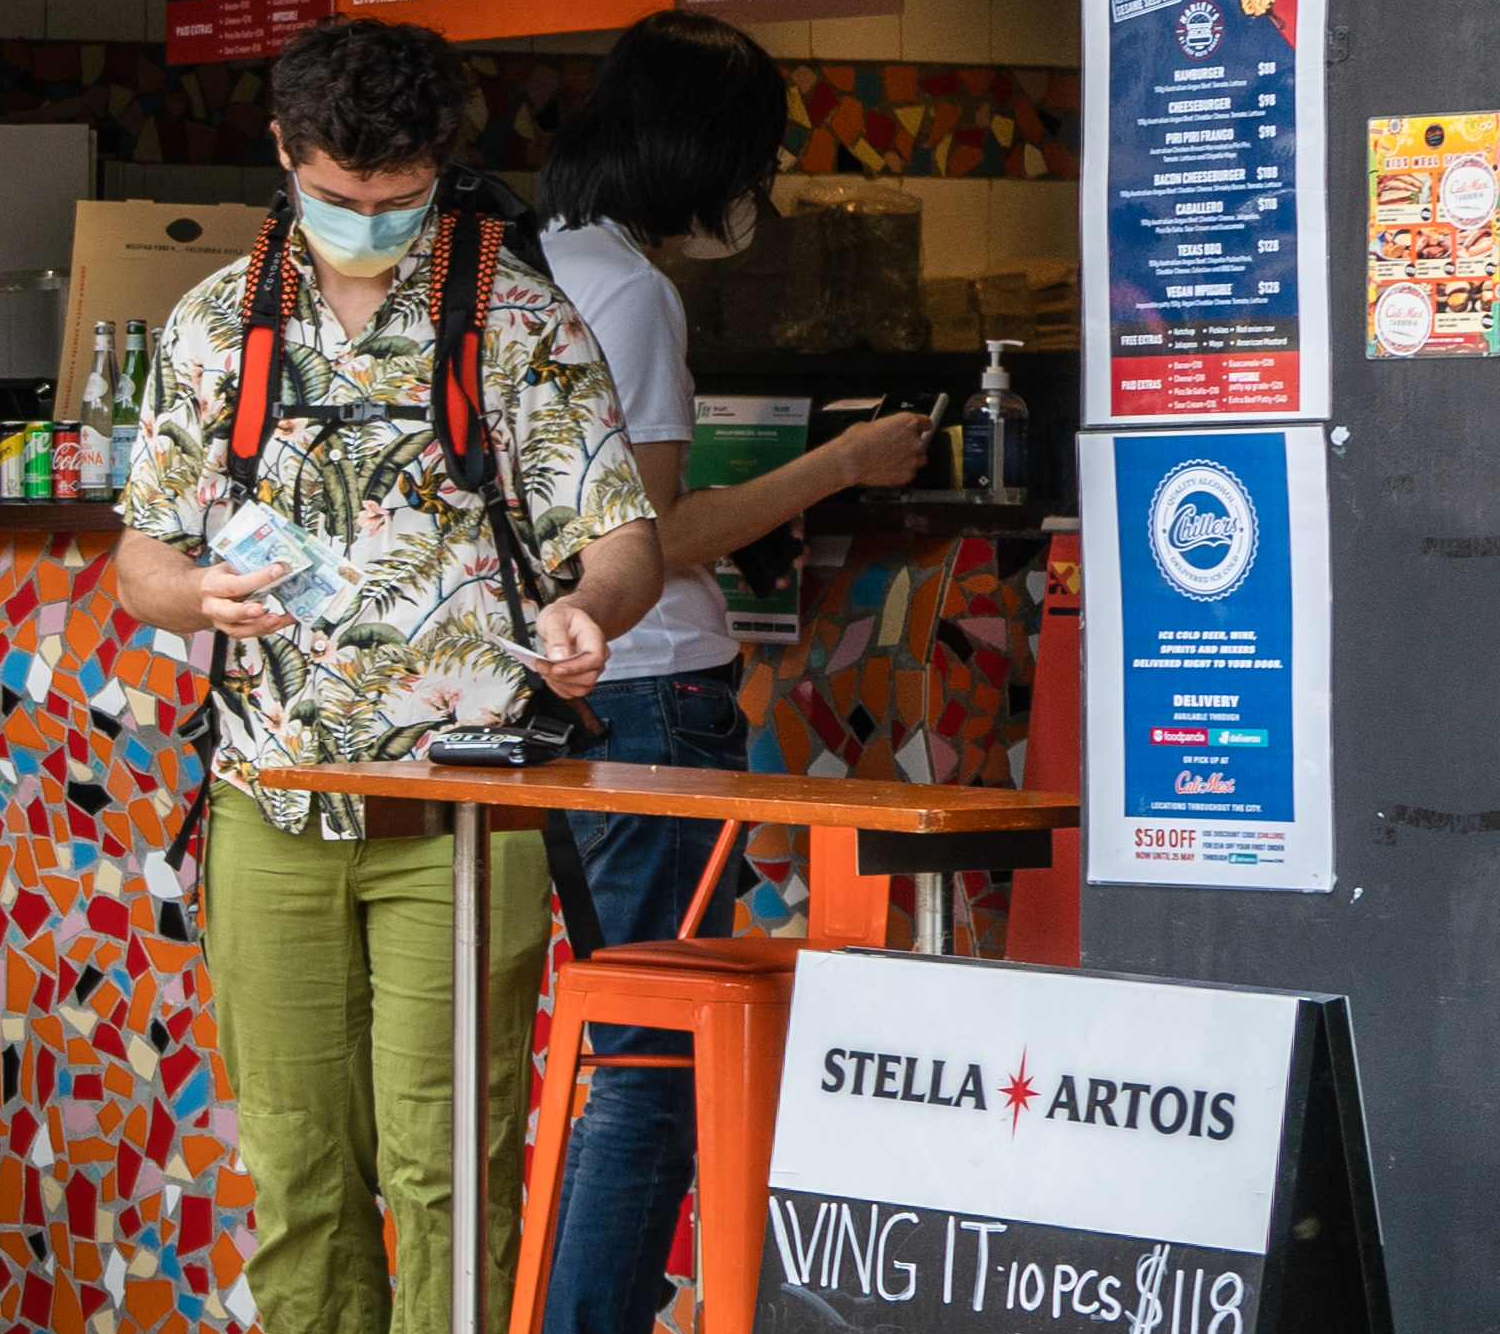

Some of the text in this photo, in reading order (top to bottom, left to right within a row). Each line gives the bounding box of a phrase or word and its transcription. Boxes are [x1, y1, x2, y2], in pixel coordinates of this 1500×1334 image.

[1174, 66, 1225, 82] HAMBURGER
[1168, 97, 1232, 114] CHEESEBURGER
[1175, 201, 1224, 216] CABALLERO
[1168, 504, 1239, 552] Chillers
[1173, 694, 1240, 708] DELIVERY
[1175, 770, 1236, 795] Cali-Mex
[1135, 827, 1197, 849] $50 OFF
[821, 1047, 1237, 1141] STELLA ARTOIS
[769, 1195, 920, 1301] WING
[943, 1215, 1008, 1312] IT
[1052, 1264, 1122, 1322] PCS
